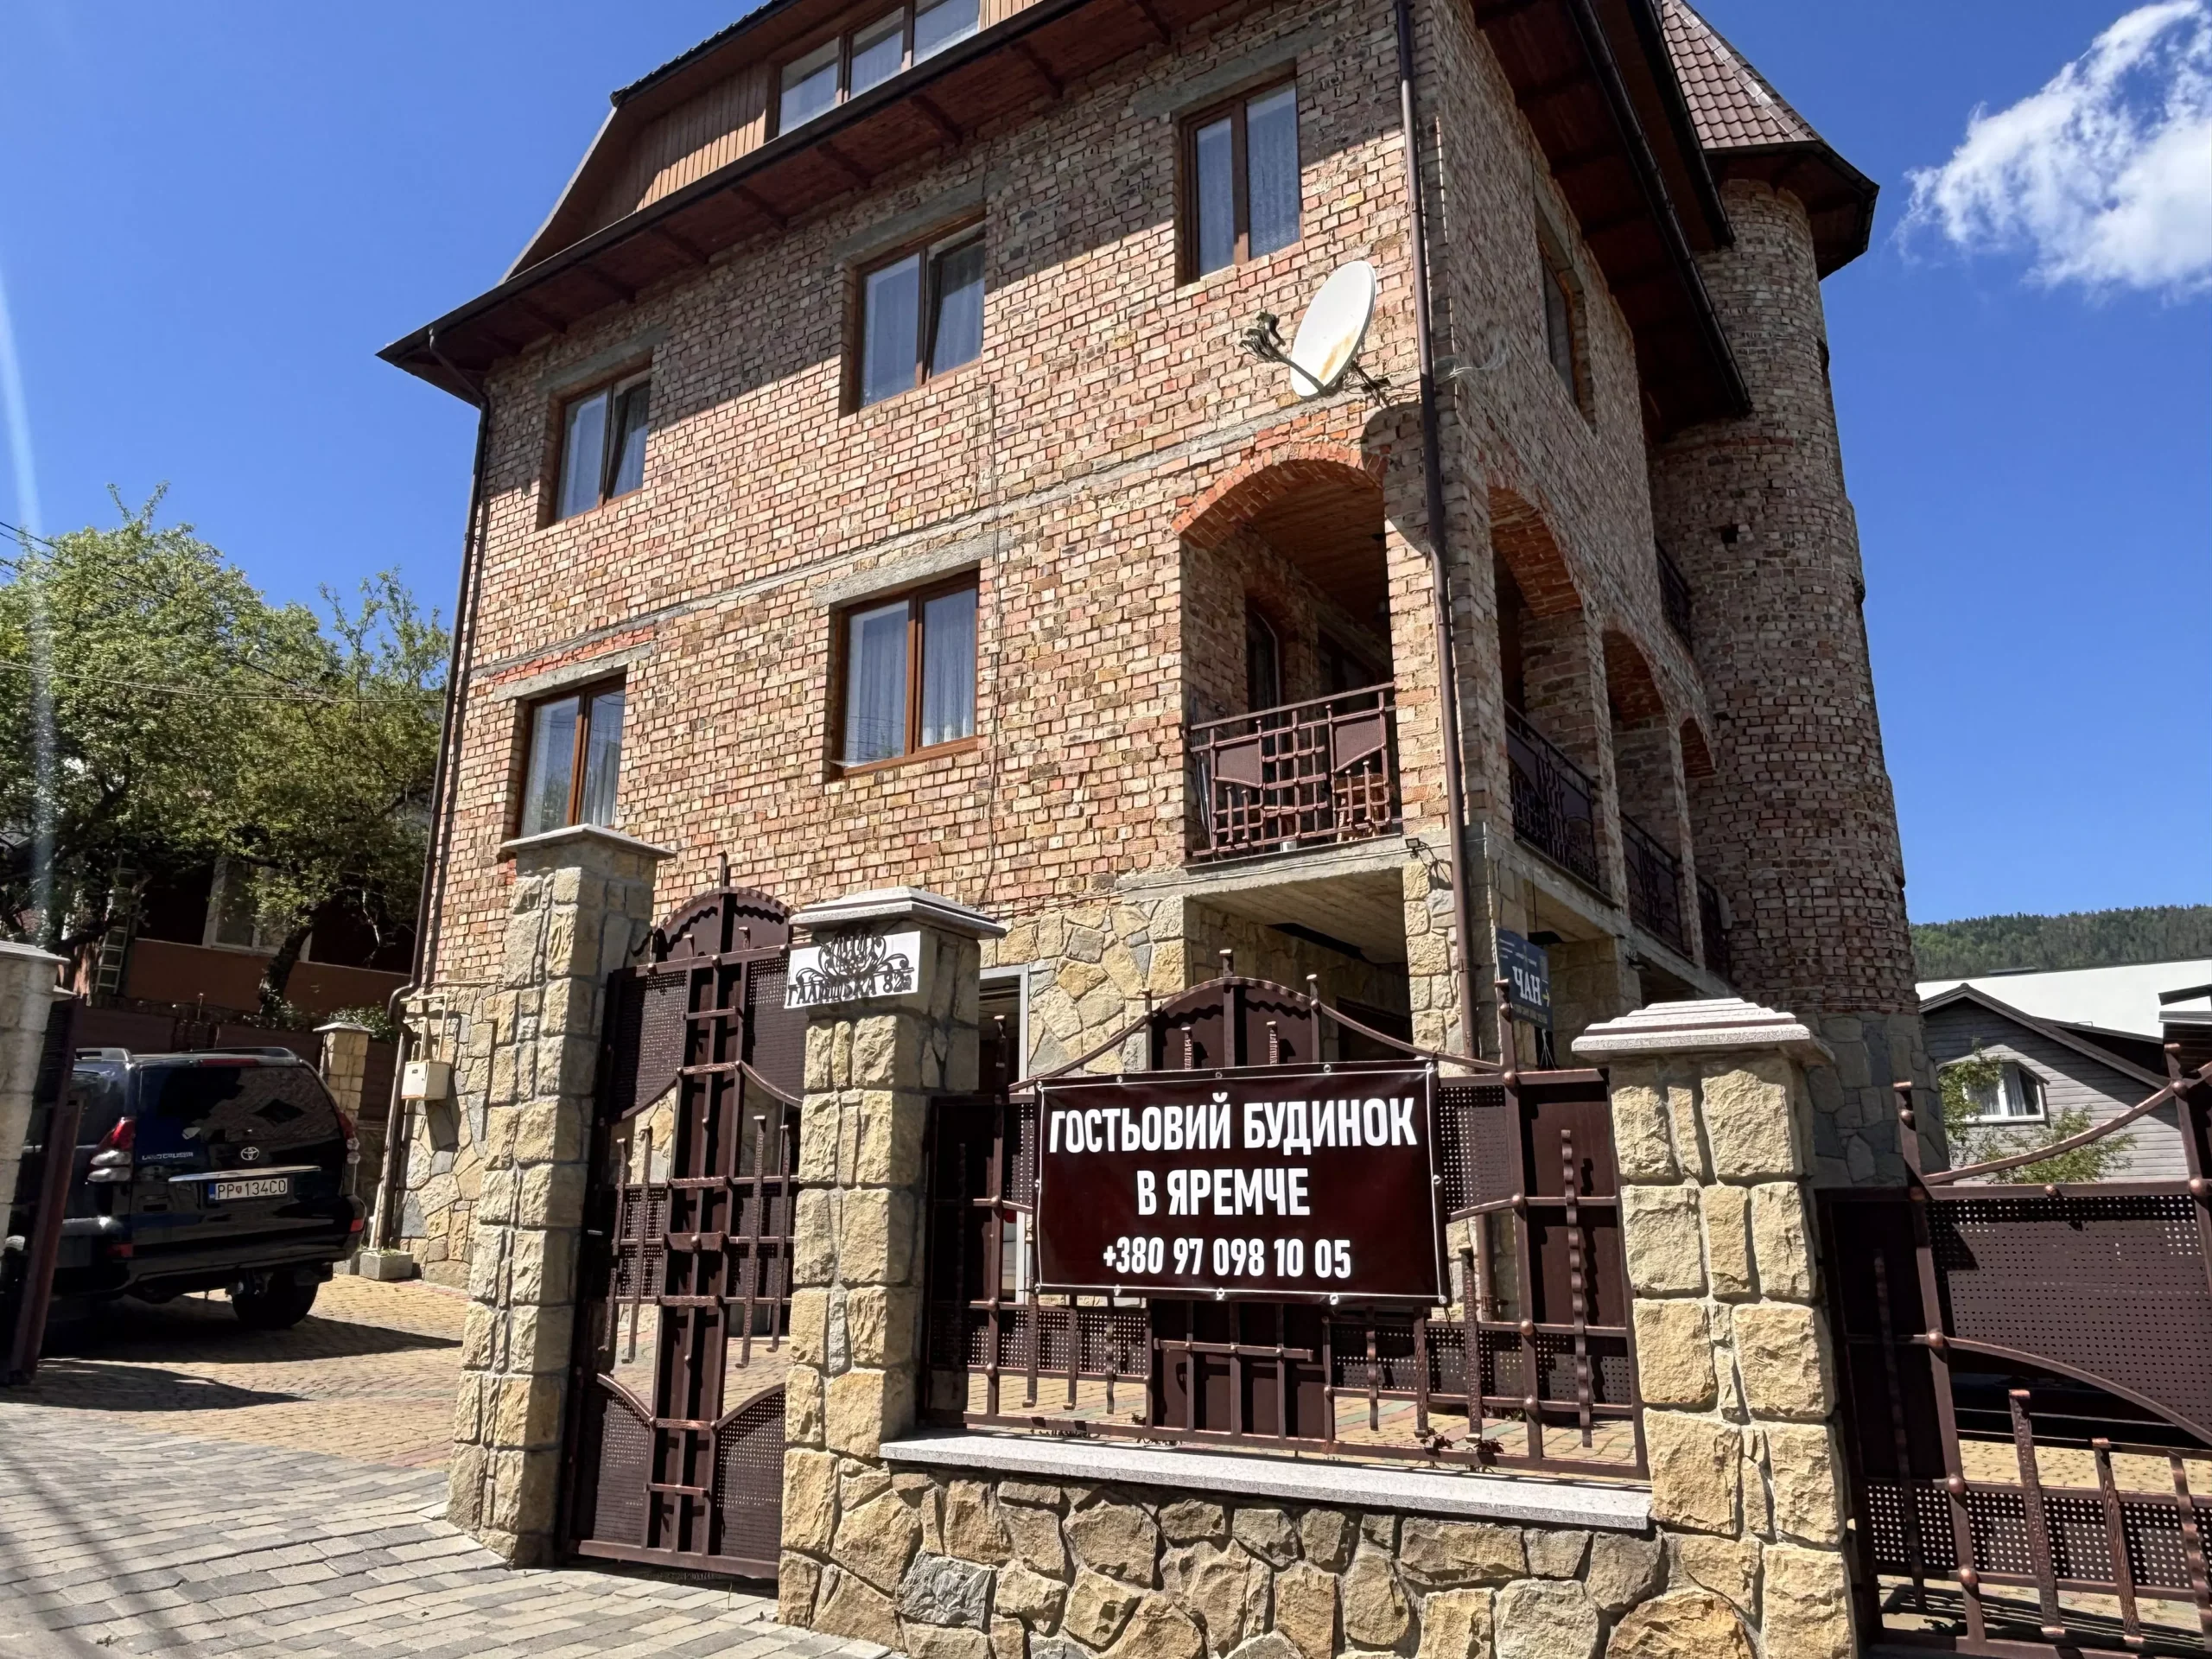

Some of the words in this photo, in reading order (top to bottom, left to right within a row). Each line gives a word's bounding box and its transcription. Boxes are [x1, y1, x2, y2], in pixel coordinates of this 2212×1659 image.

[1512, 966, 1542, 1006] ЧАН
[1049, 1092, 1231, 1154] ГОСТЬОВИЙ
[1243, 1097, 1418, 1156] БУДИНОК
[218, 1183, 235, 1199] PP
[1136, 1170, 1157, 1216] В
[1166, 1167, 1311, 1216] ЯРЕМЧЕ
[1103, 1236, 1165, 1274] +380
[1173, 1237, 1204, 1275] 97
[1212, 1237, 1265, 1277] 098
[1274, 1238, 1304, 1277] 10
[1314, 1239, 1351, 1279] 05
